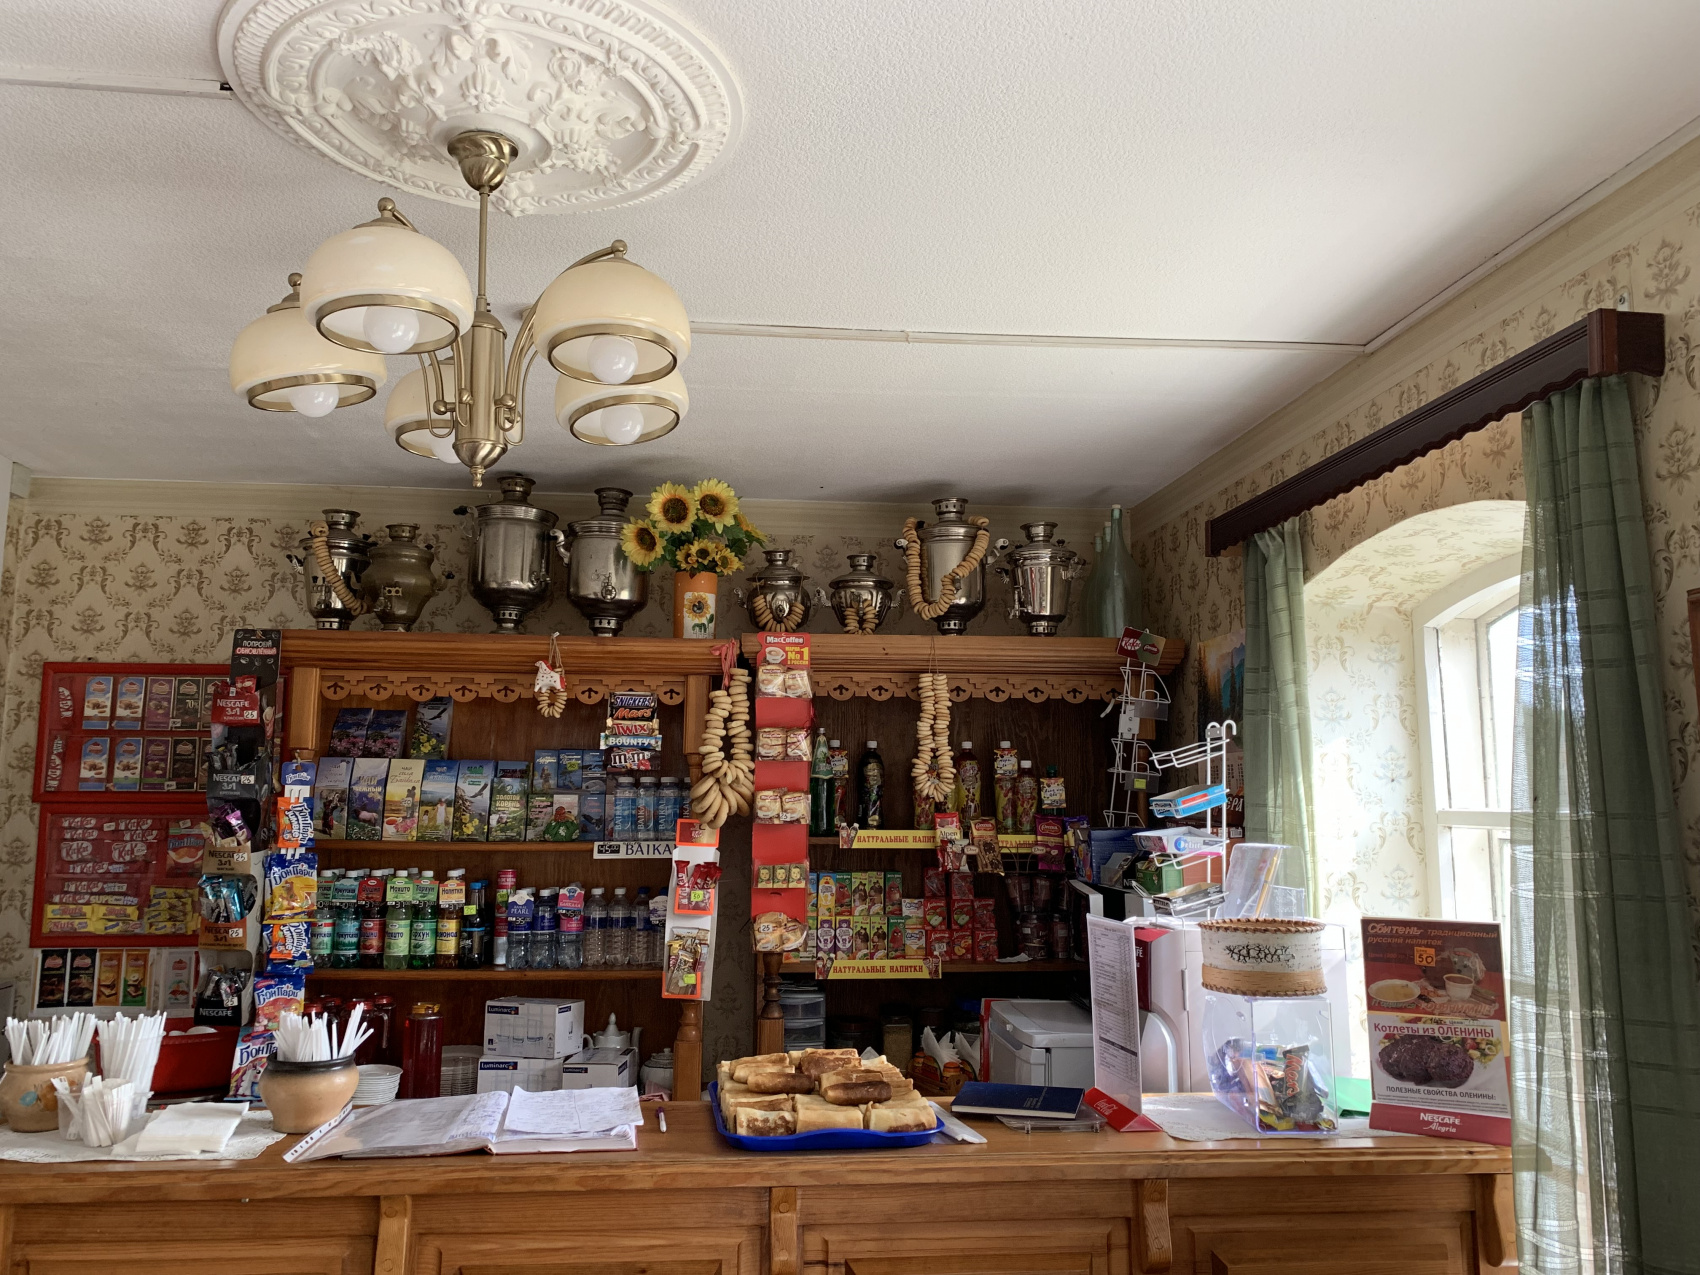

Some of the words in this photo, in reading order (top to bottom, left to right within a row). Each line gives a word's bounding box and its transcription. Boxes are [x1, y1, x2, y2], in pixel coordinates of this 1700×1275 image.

[766, 636, 803, 644] MacCoffee
[614, 695, 652, 707] SNICKERS
[613, 708, 653, 719] Mars
[609, 737, 650, 747] BOUNTY
[857, 835, 909, 844] НАТУРАЛЬНЫЕ
[913, 836, 936, 844] НАПИТ
[1367, 923, 1424, 936] Сбитень
[1427, 929, 1498, 938] традиционный
[1367, 936, 1403, 944] русский
[1418, 954, 1434, 963] 50
[832, 965, 885, 974] НАТУРАЛЬНЫЕ
[888, 964, 923, 973] НАПИТКИ
[488, 1005, 511, 1013] Luminarc
[1374, 1023, 1419, 1034] Котлеты
[1438, 1026, 1494, 1038] ОЛЕНИНЫ
[239, 1042, 278, 1066] БонПа
[481, 1061, 509, 1070] Luminarc
[1286, 1054, 1303, 1096] Mars
[1386, 1085, 1421, 1095] ПОЛЕЗНЫЕ
[1423, 1088, 1458, 1097] СВОЙСТВА
[1459, 1091, 1496, 1100] ОЛЕНИНЫ:
[1423, 1123, 1456, 1133] Alegria
